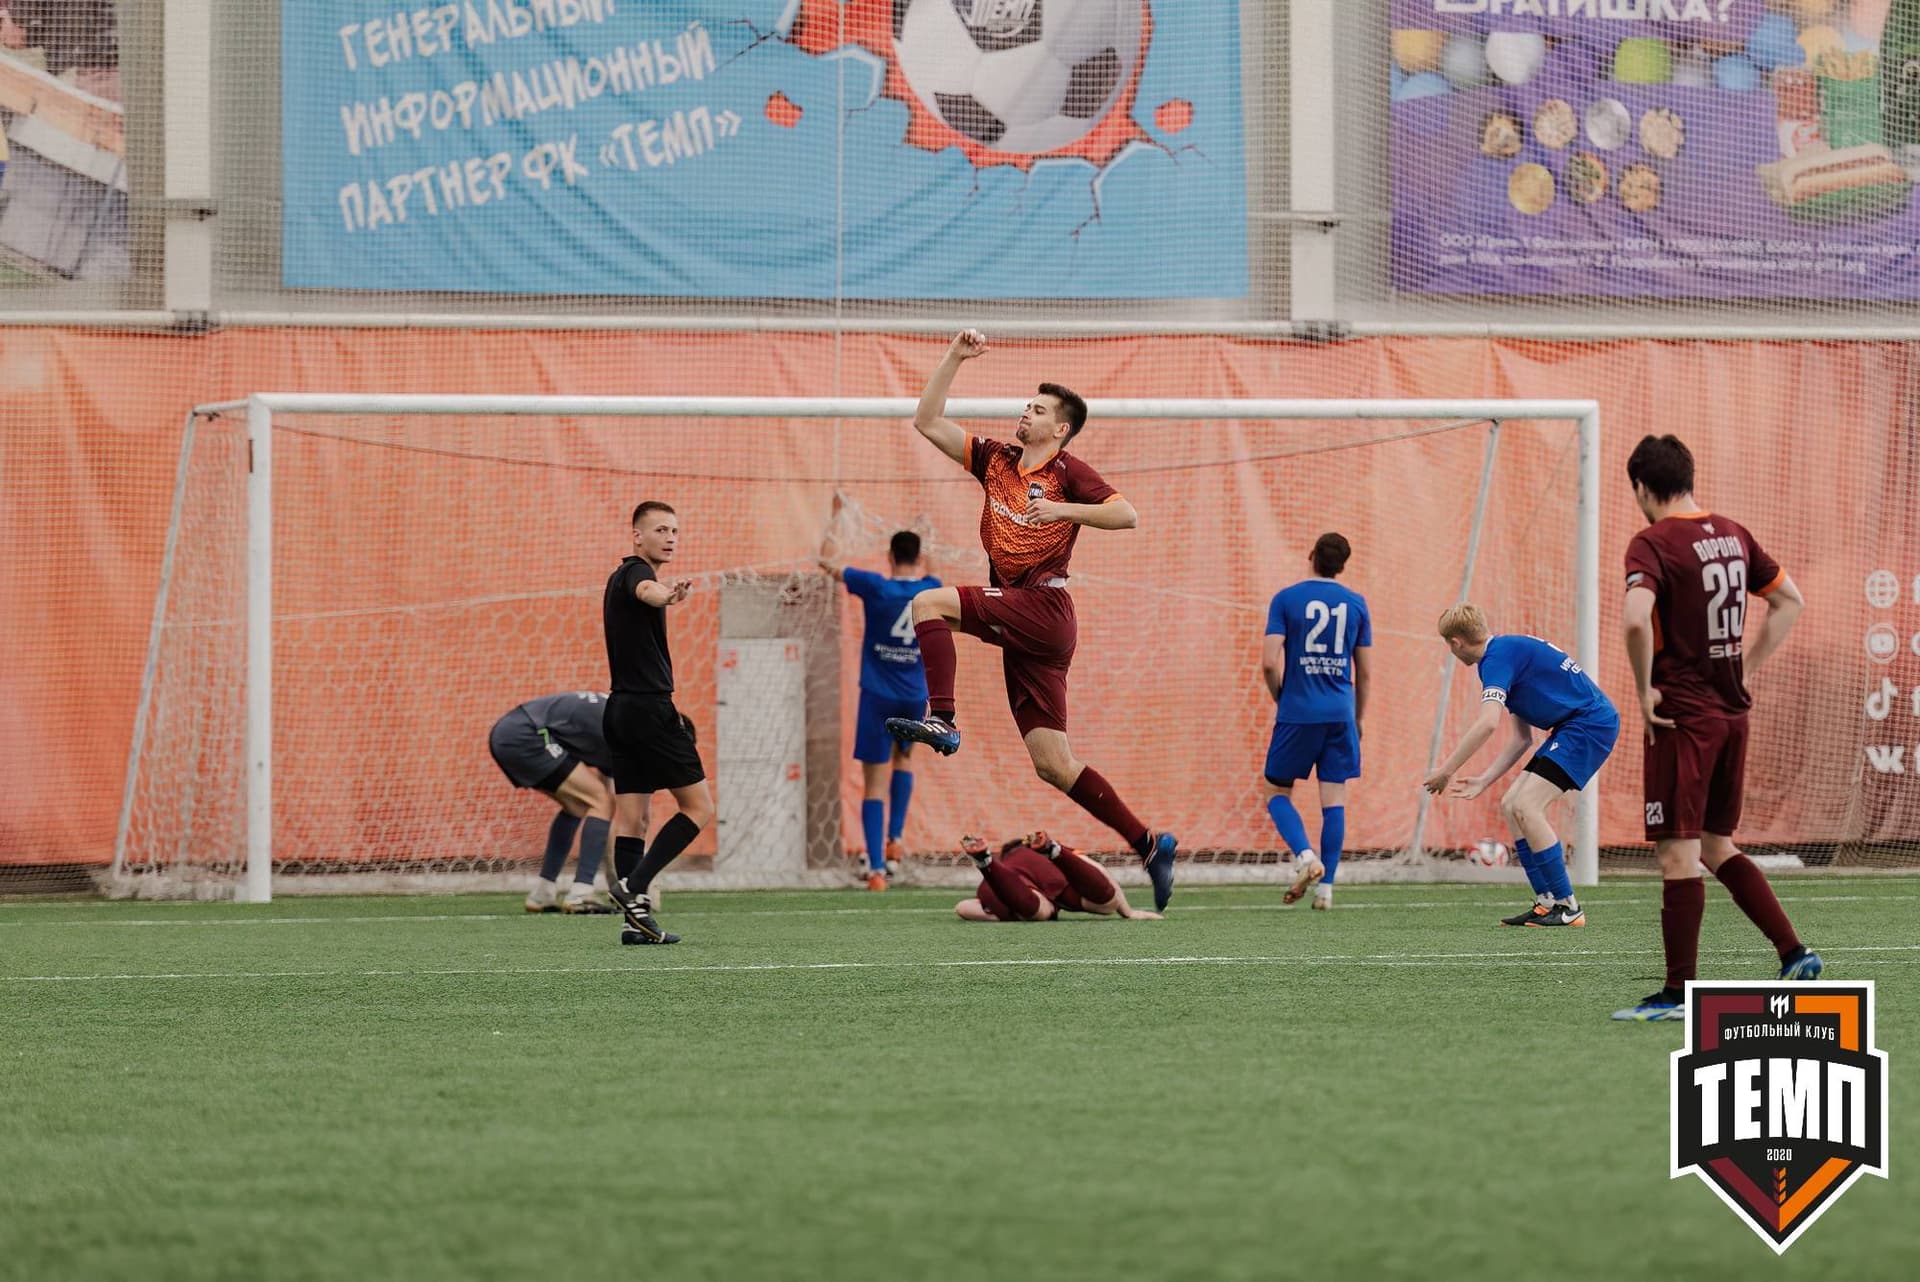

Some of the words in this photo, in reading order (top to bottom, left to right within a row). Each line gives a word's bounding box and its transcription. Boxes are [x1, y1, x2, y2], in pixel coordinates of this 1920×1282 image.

[341, 19, 715, 156] ИНФОРМАЦИОННЫЙ
[339, 152, 511, 232] ПАРТНЕР
[523, 134, 589, 190] ФК
[602, 106, 742, 171] «ТЕМП»
[890, 599, 917, 646] 4
[1305, 600, 1348, 655] 21
[1702, 560, 1747, 640] 23
[1645, 801, 1665, 825] 23
